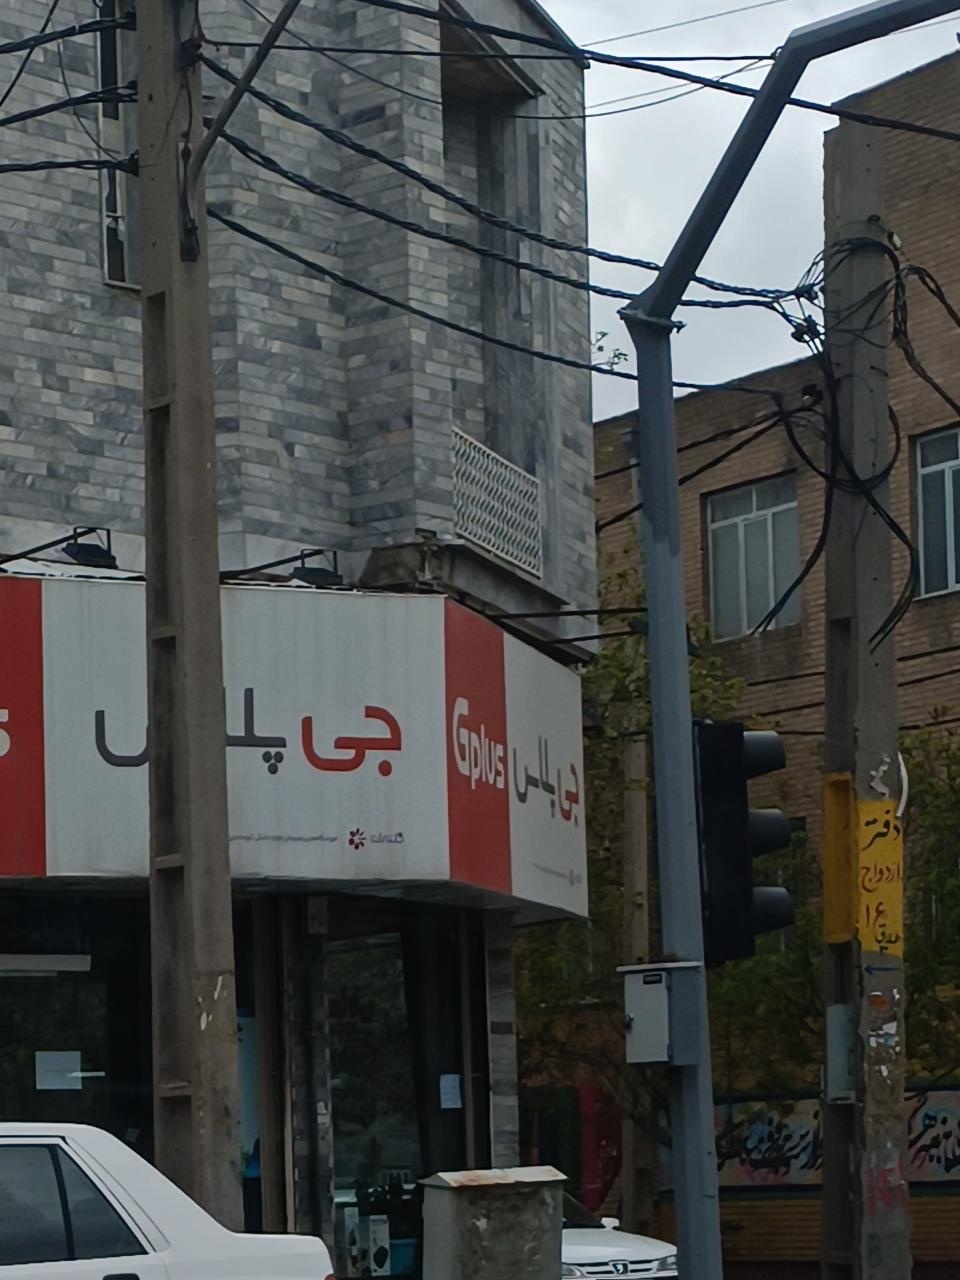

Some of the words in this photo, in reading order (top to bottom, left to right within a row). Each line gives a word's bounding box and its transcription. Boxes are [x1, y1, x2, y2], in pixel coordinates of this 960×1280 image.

[301, 705, 402, 777] جی
[452, 697, 505, 790] Gplus
[862, 809, 900, 851] دفتر
[861, 862, 901, 893] ازدواج
